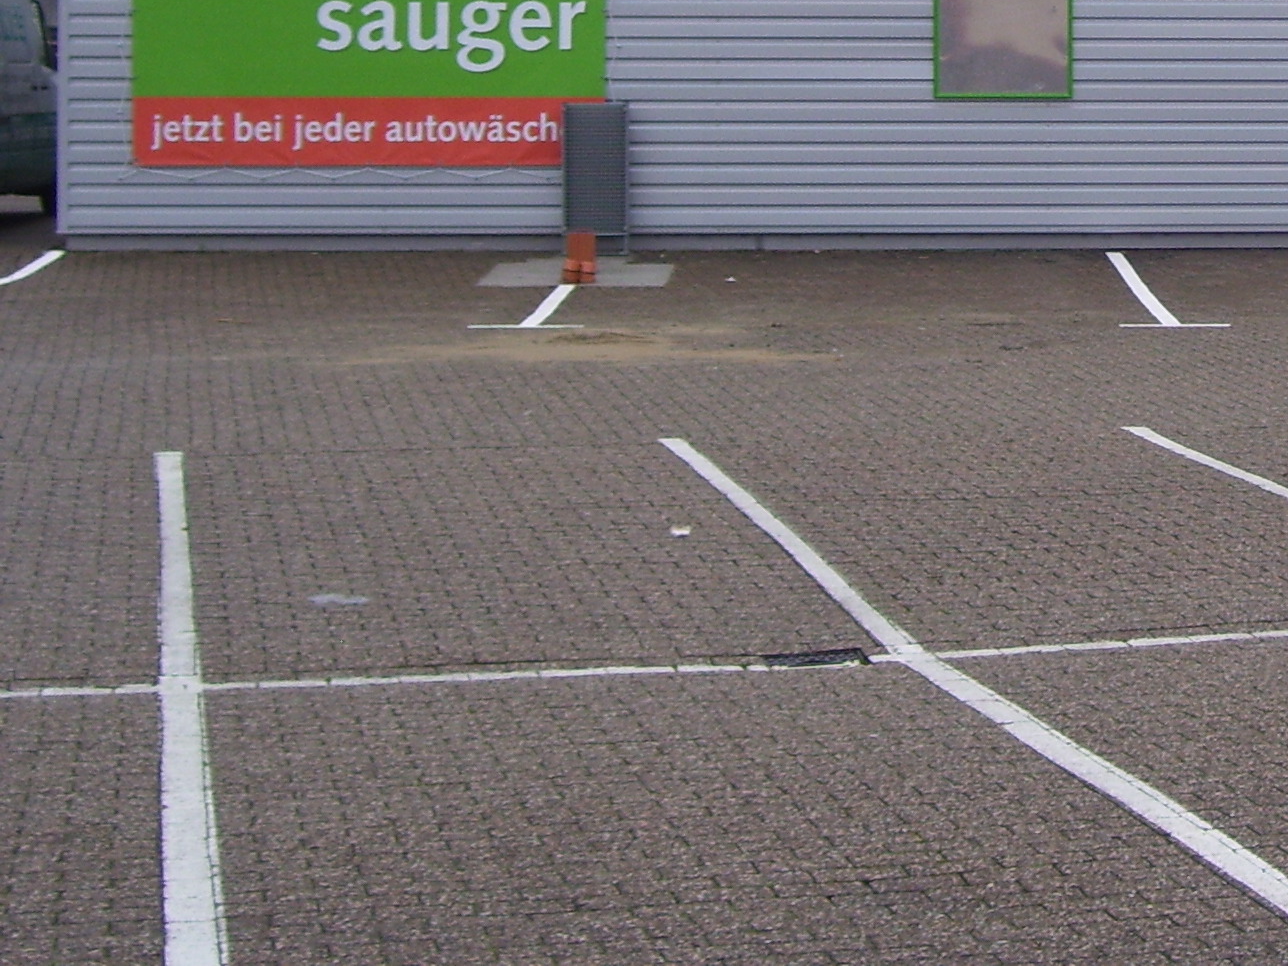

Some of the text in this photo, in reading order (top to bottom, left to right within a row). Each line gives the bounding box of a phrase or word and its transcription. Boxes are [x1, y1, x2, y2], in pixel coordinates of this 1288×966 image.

[315, 0, 587, 73] sauger
[151, 112, 563, 151] jetzt bei jeder autowäsch
